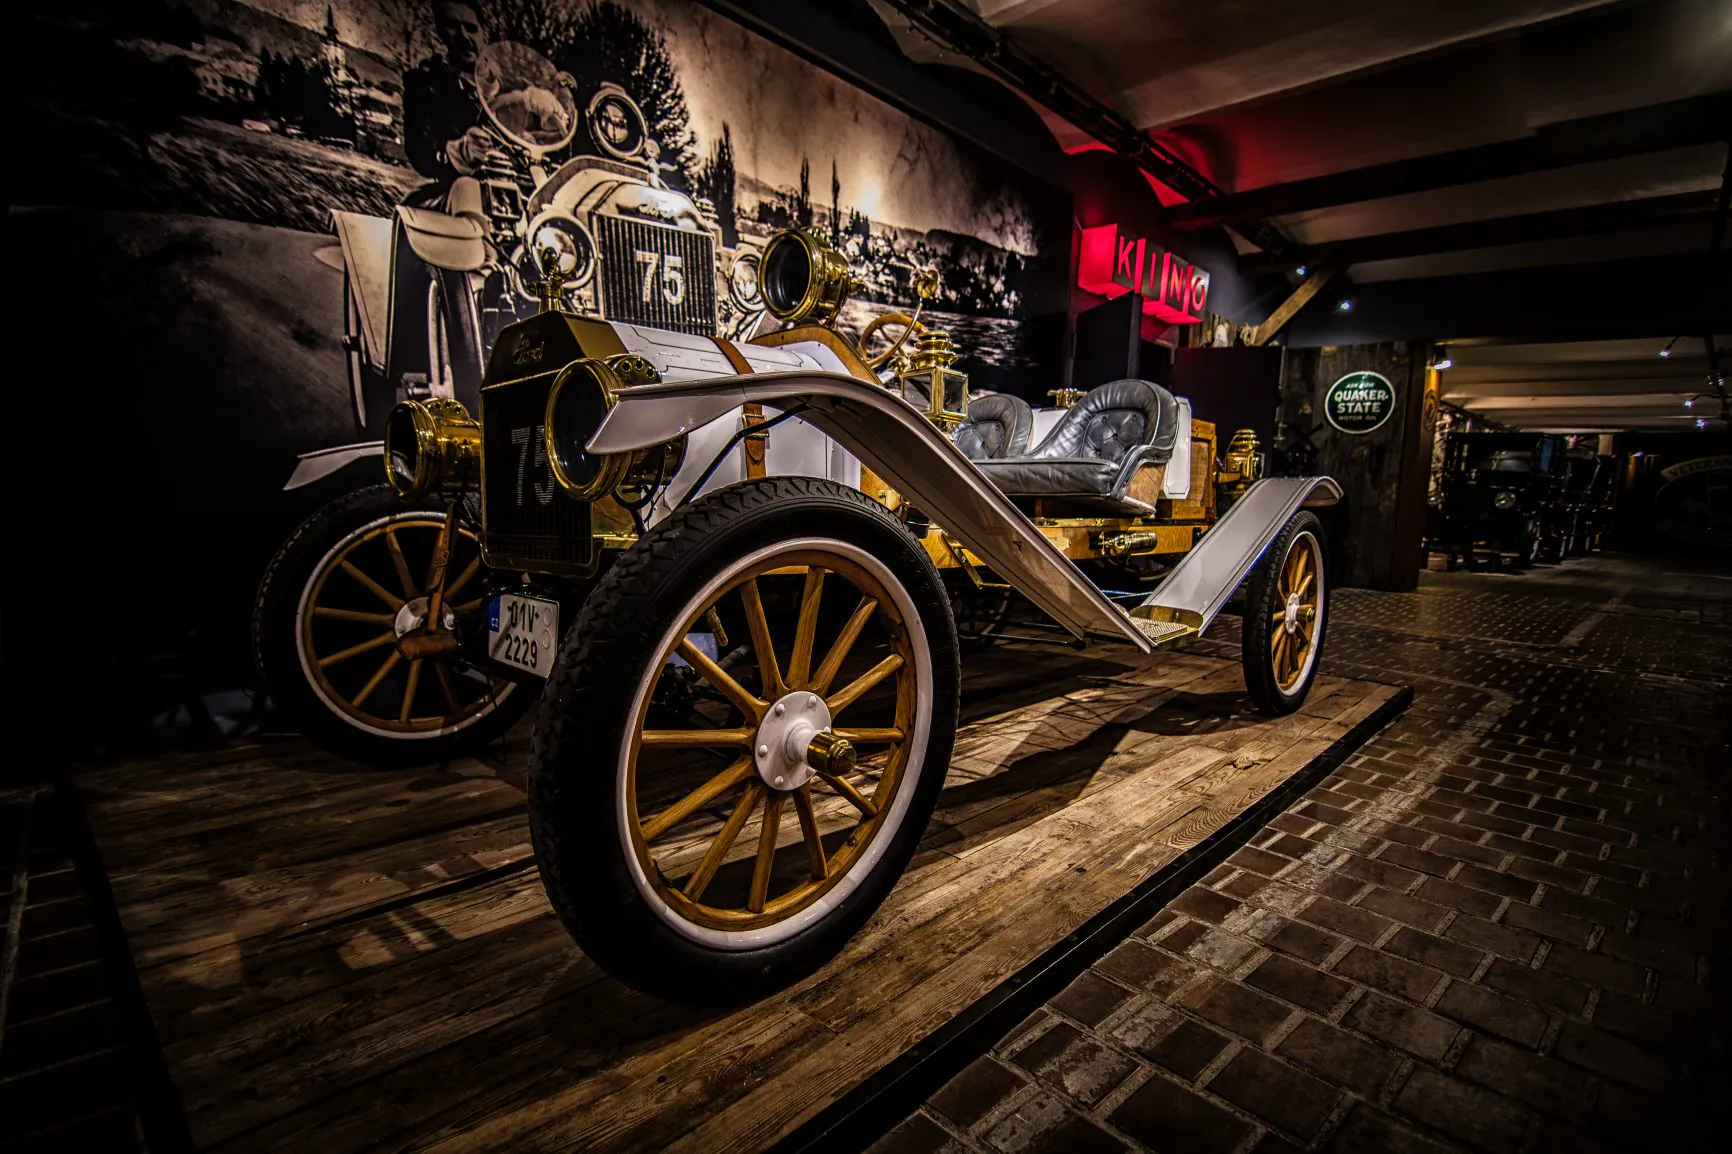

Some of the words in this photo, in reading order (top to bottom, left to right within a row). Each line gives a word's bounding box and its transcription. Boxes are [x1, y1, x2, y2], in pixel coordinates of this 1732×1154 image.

[635, 249, 686, 306] 75
[1117, 235, 1206, 312] KINO
[1334, 388, 1387, 402] QUAKER
[1337, 401, 1382, 414] STATE
[511, 425, 555, 506] 75
[490, 617, 499, 628] CZ
[504, 633, 538, 669] 2229
